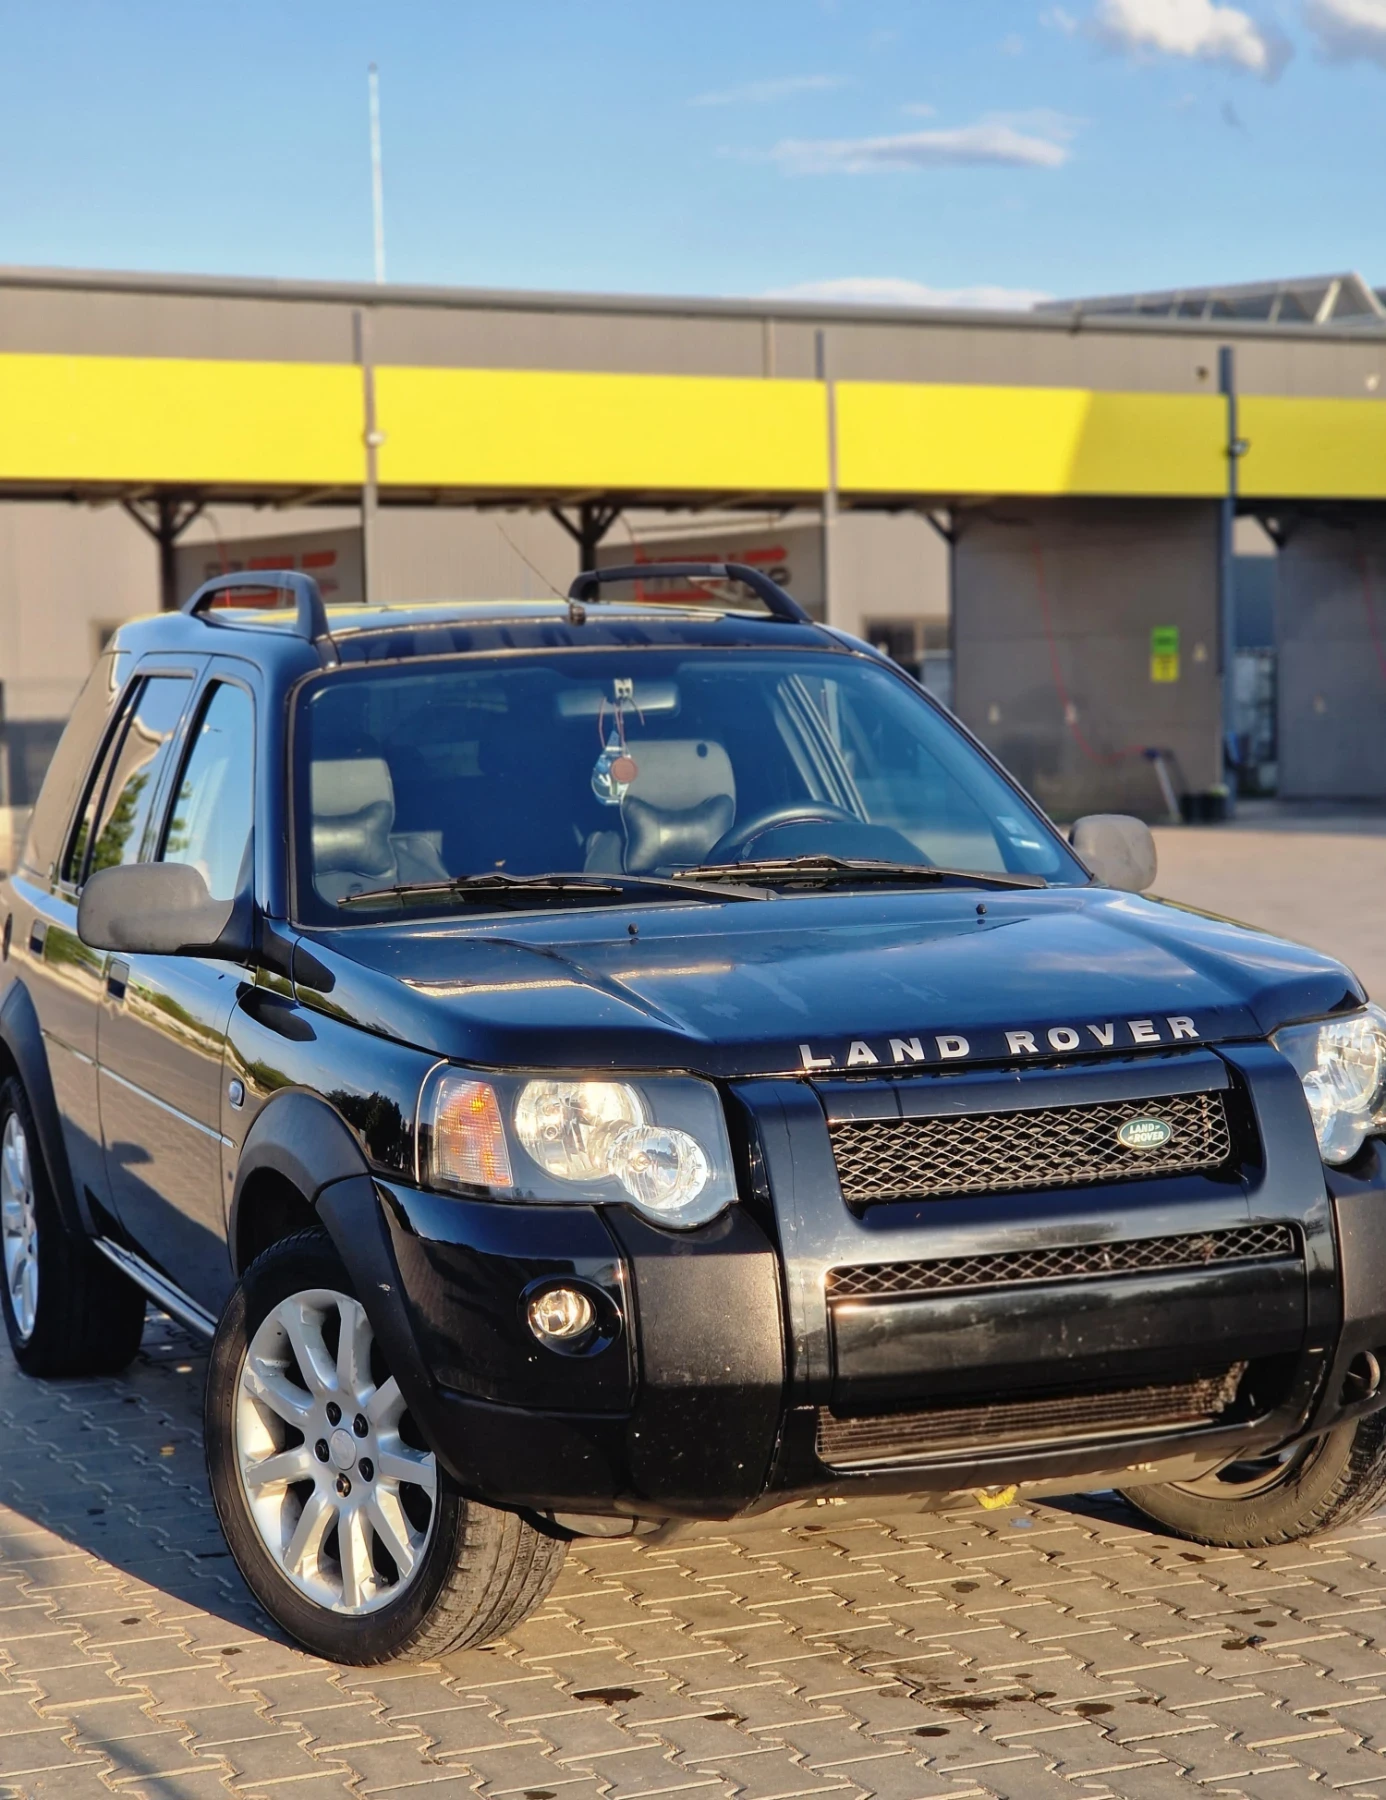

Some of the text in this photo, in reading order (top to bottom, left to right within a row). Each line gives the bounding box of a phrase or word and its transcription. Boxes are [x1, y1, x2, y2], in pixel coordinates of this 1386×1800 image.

[799, 1016, 1200, 1069] LAND ROVER
[1129, 1123, 1155, 1134] LAND
[1134, 1131, 1164, 1143] ROVER
